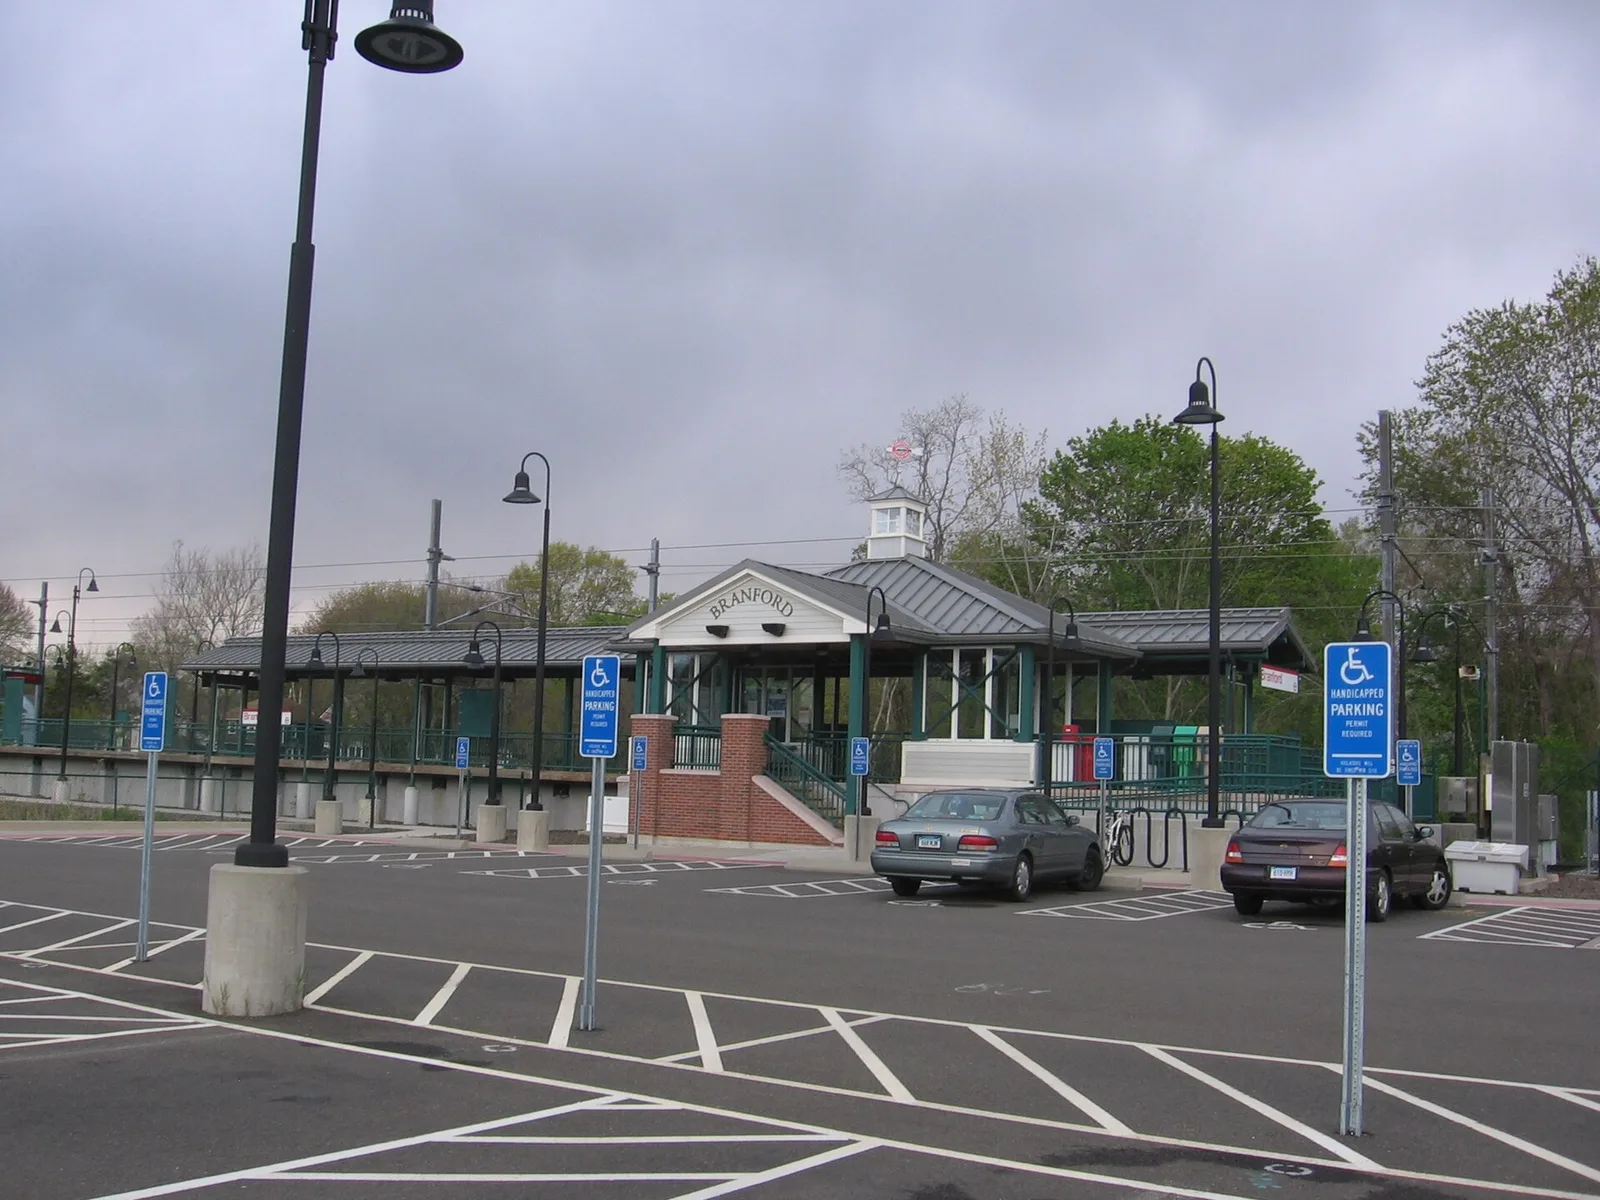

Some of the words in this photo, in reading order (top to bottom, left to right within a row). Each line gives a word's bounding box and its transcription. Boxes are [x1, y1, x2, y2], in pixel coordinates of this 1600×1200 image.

[709, 587, 794, 620] BRANFORD
[1330, 688, 1384, 699] HANDICAPPED
[584, 701, 615, 711] PARKING
[1331, 703, 1384, 717] PARKING
[1345, 720, 1368, 728] PERMIT
[1341, 730, 1373, 738] REQUIRED
